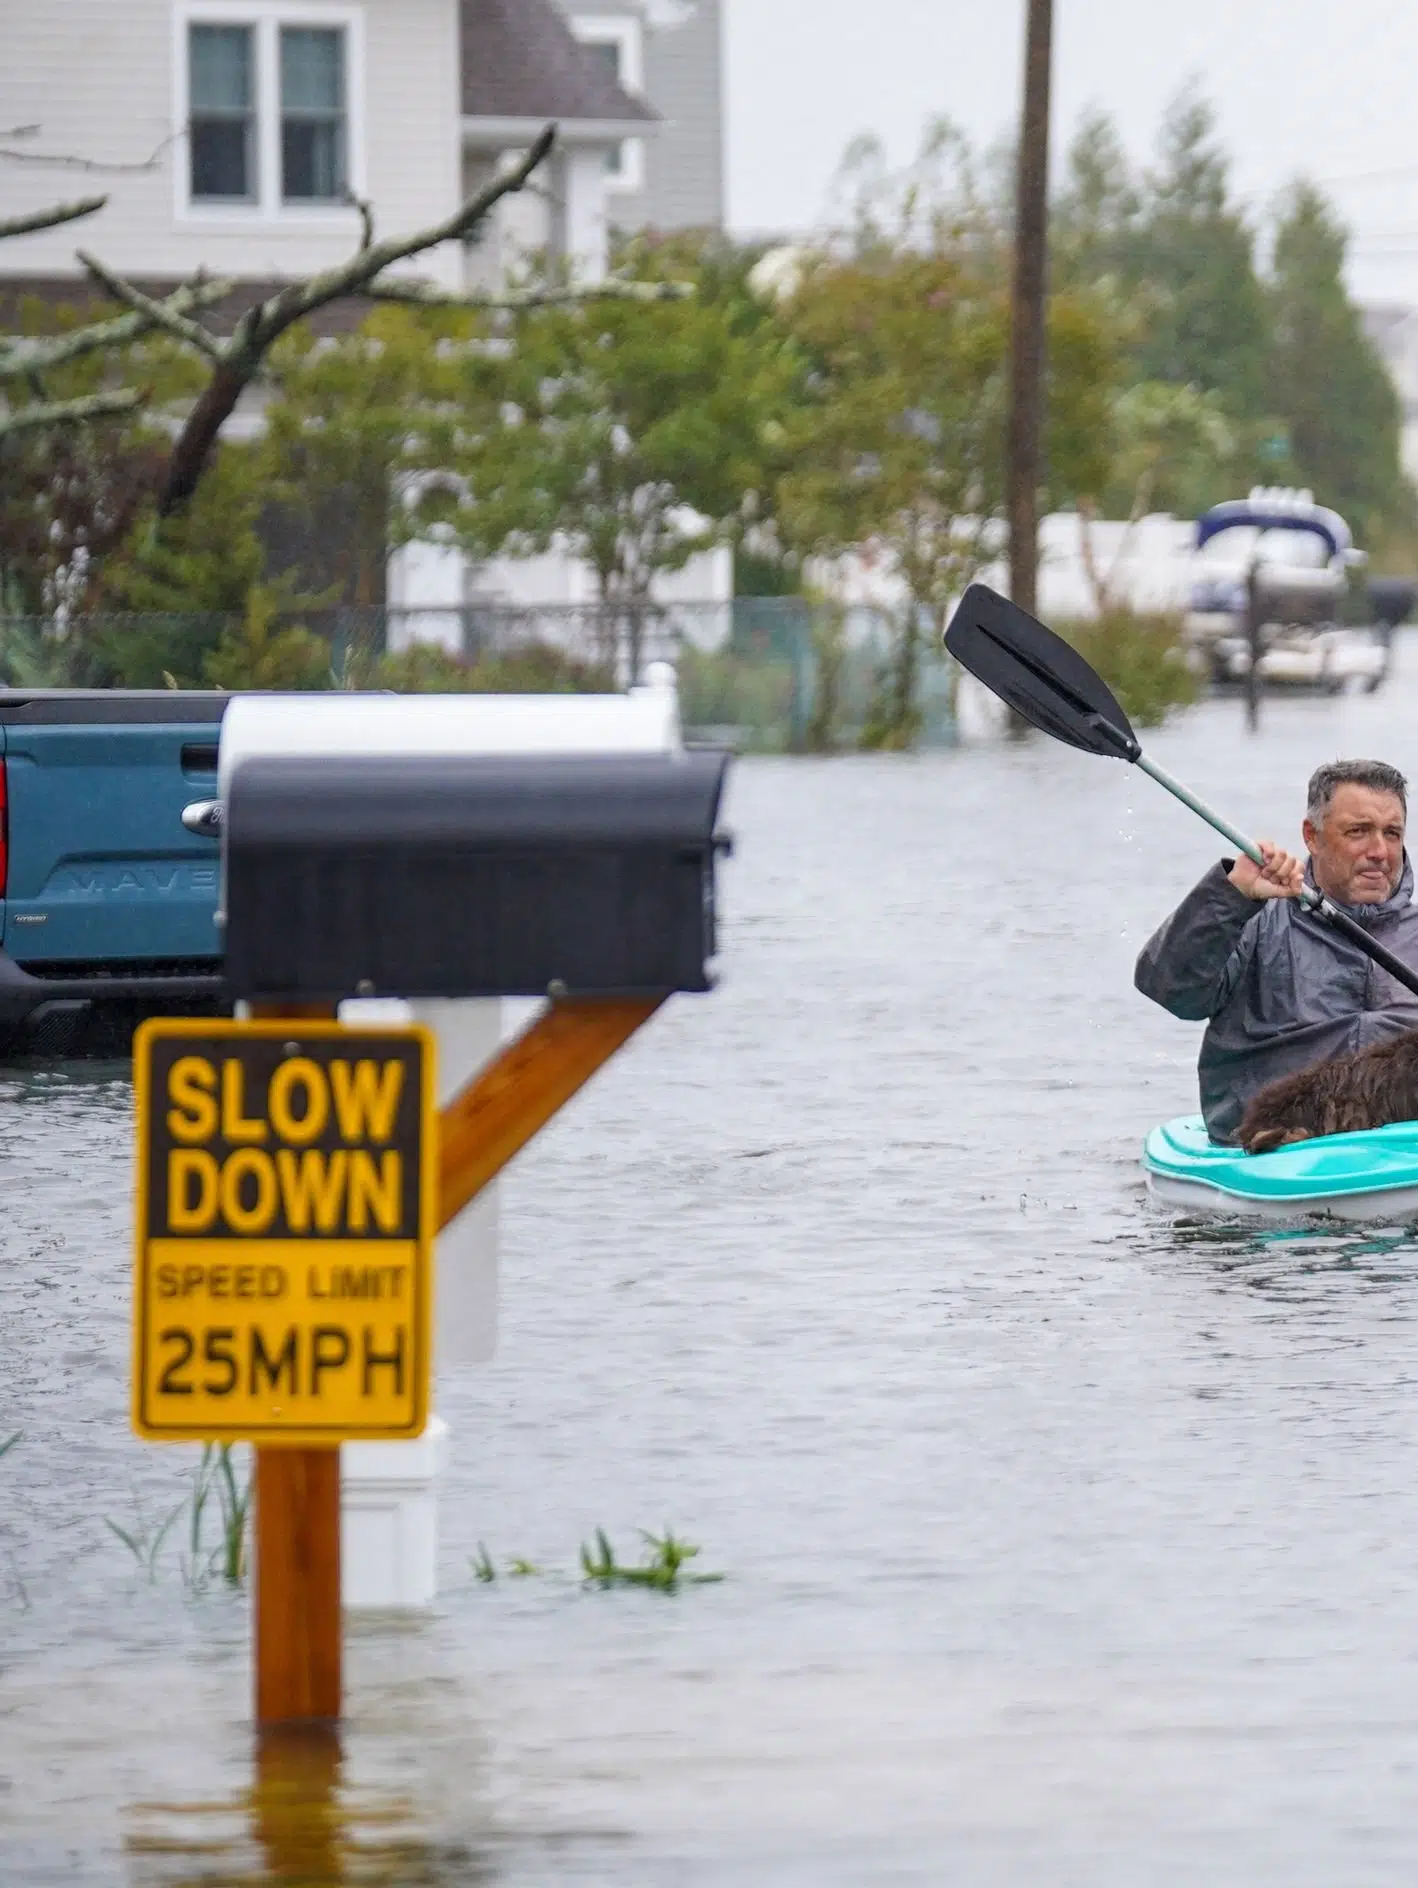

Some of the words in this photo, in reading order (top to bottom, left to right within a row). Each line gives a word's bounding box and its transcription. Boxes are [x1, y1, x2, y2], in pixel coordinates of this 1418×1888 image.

[167, 1056, 404, 1145] SLOW
[167, 1148, 403, 1232] DOWN
[157, 1264, 287, 1299] SPEED
[307, 1265, 406, 1299] LIMIT
[158, 1324, 405, 1397] 25MPH
